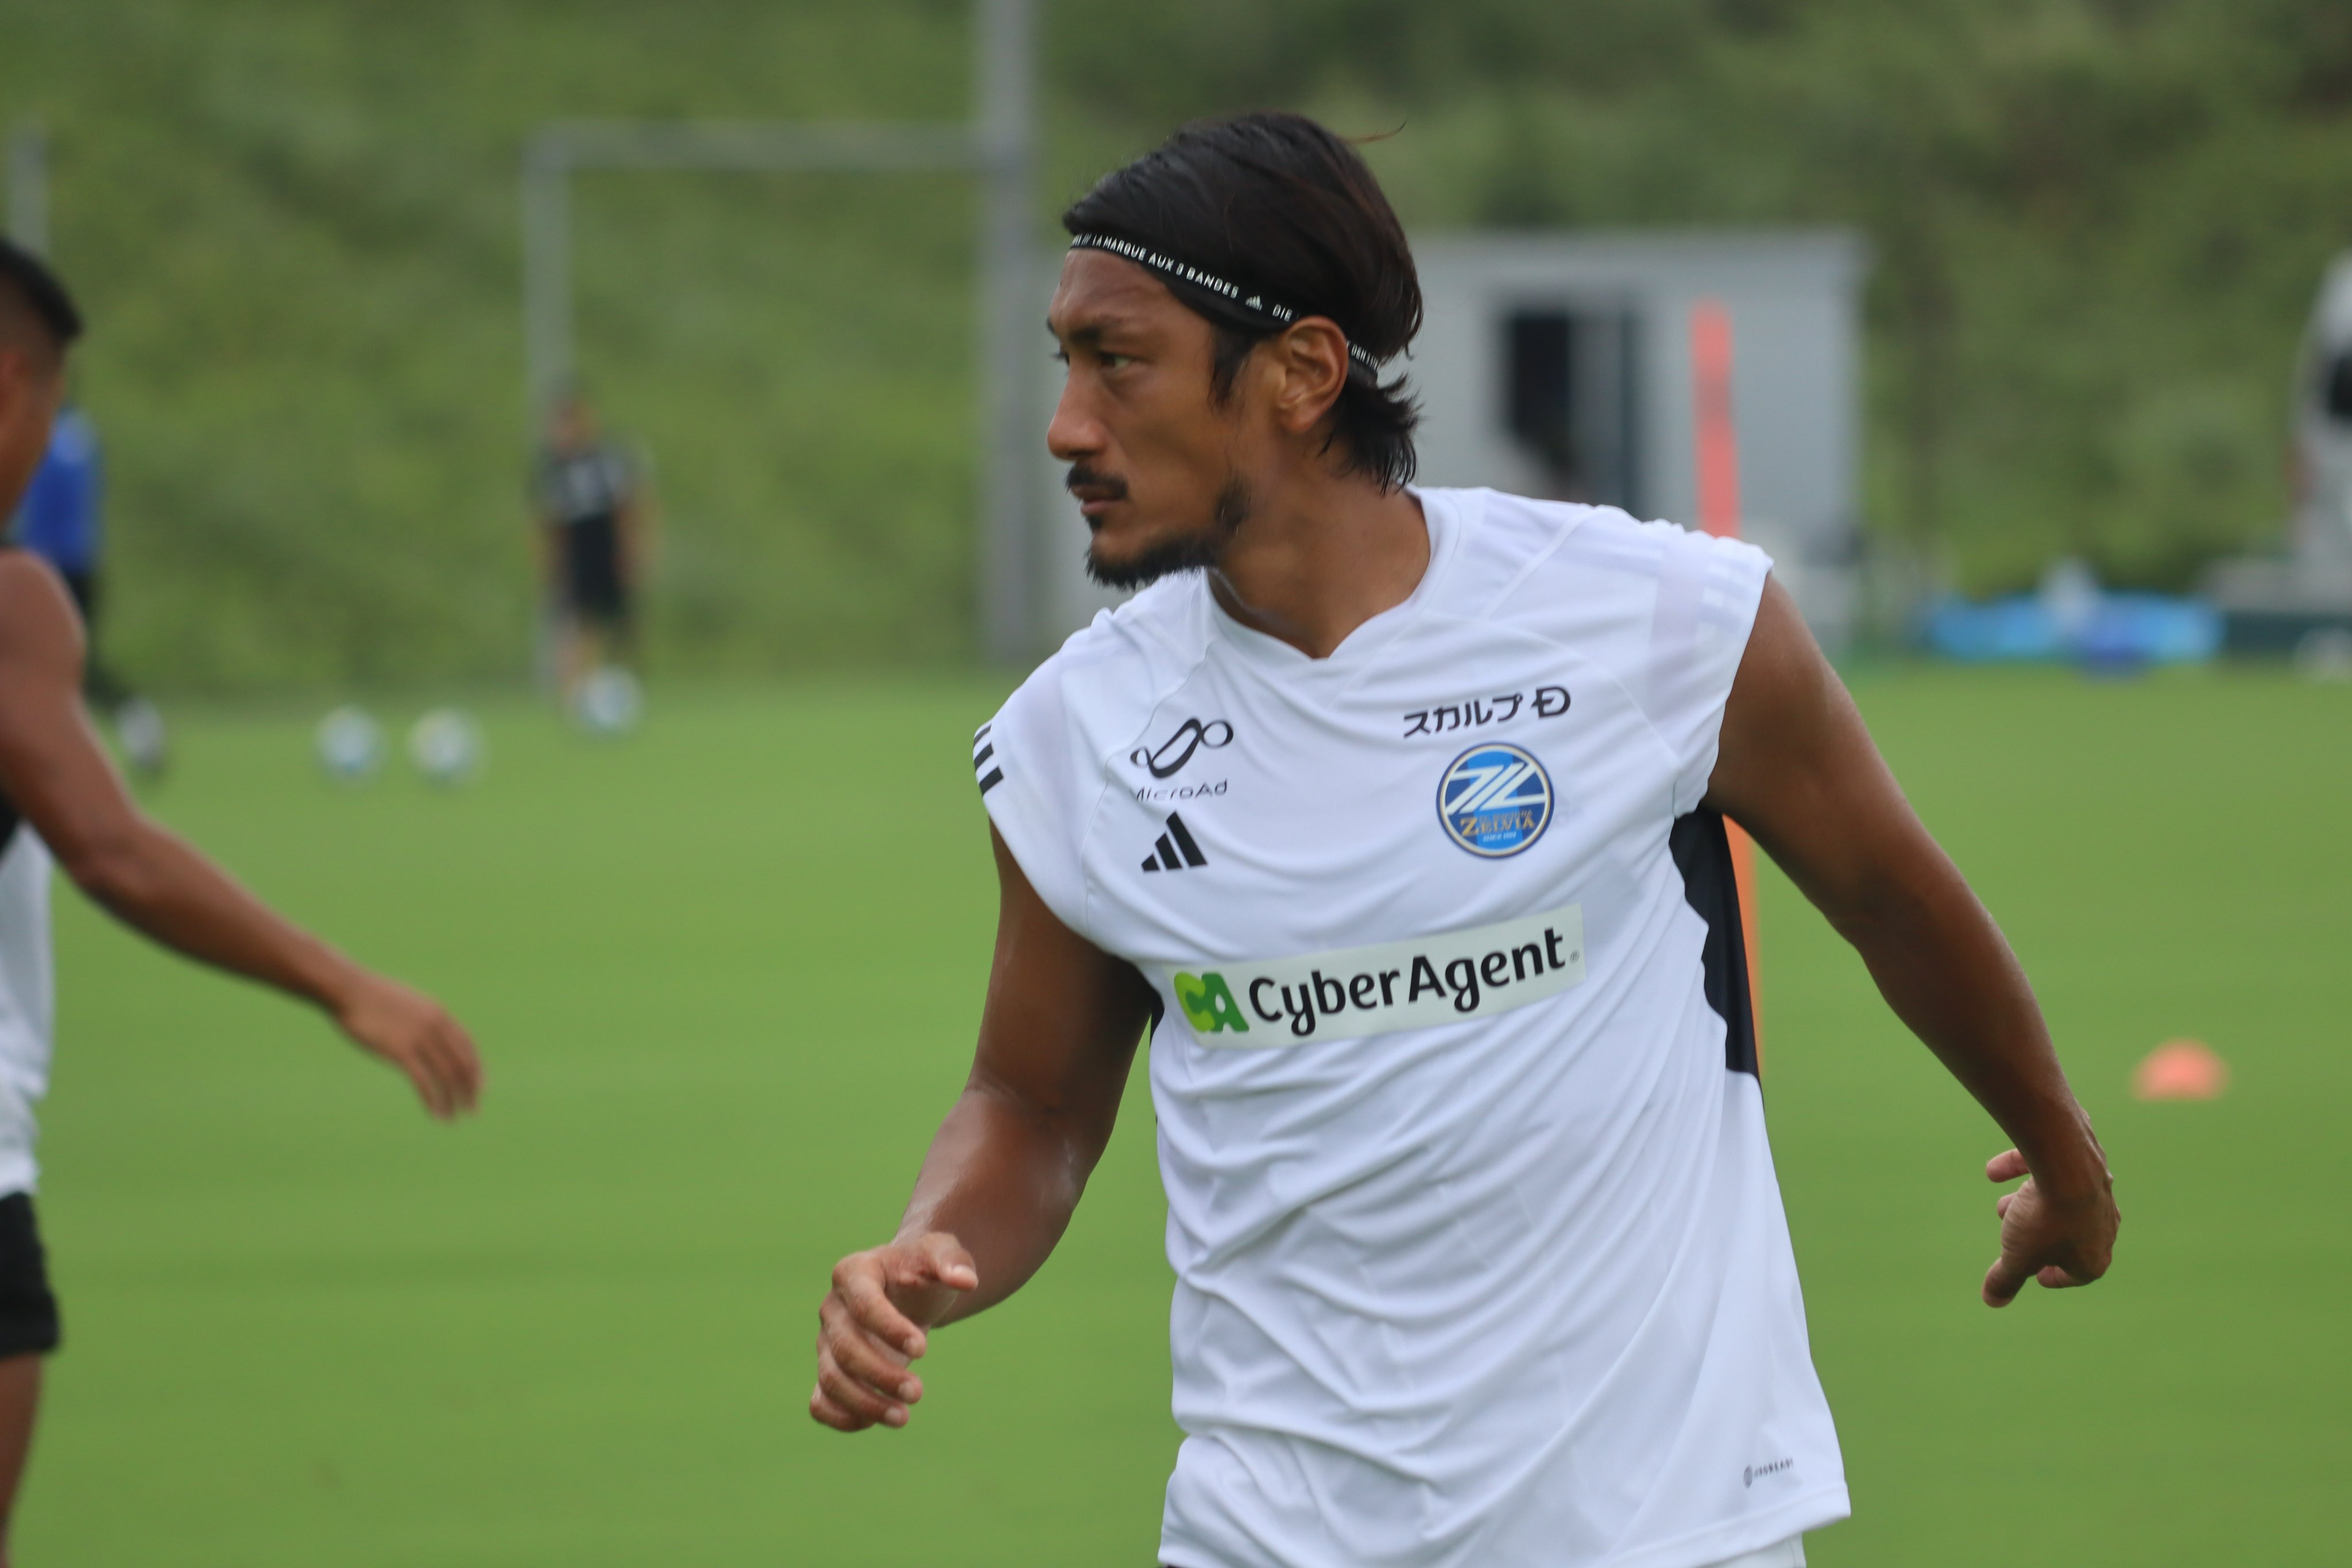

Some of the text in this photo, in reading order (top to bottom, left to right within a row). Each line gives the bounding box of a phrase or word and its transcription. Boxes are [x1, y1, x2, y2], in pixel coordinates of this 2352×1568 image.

[1103, 235, 1147, 261] MARQUE
[1148, 252, 1174, 272] AUX
[1186, 266, 1239, 299] BANDES
[1272, 304, 1293, 322] DIE
[1249, 927, 1566, 1036] CyberAgent
